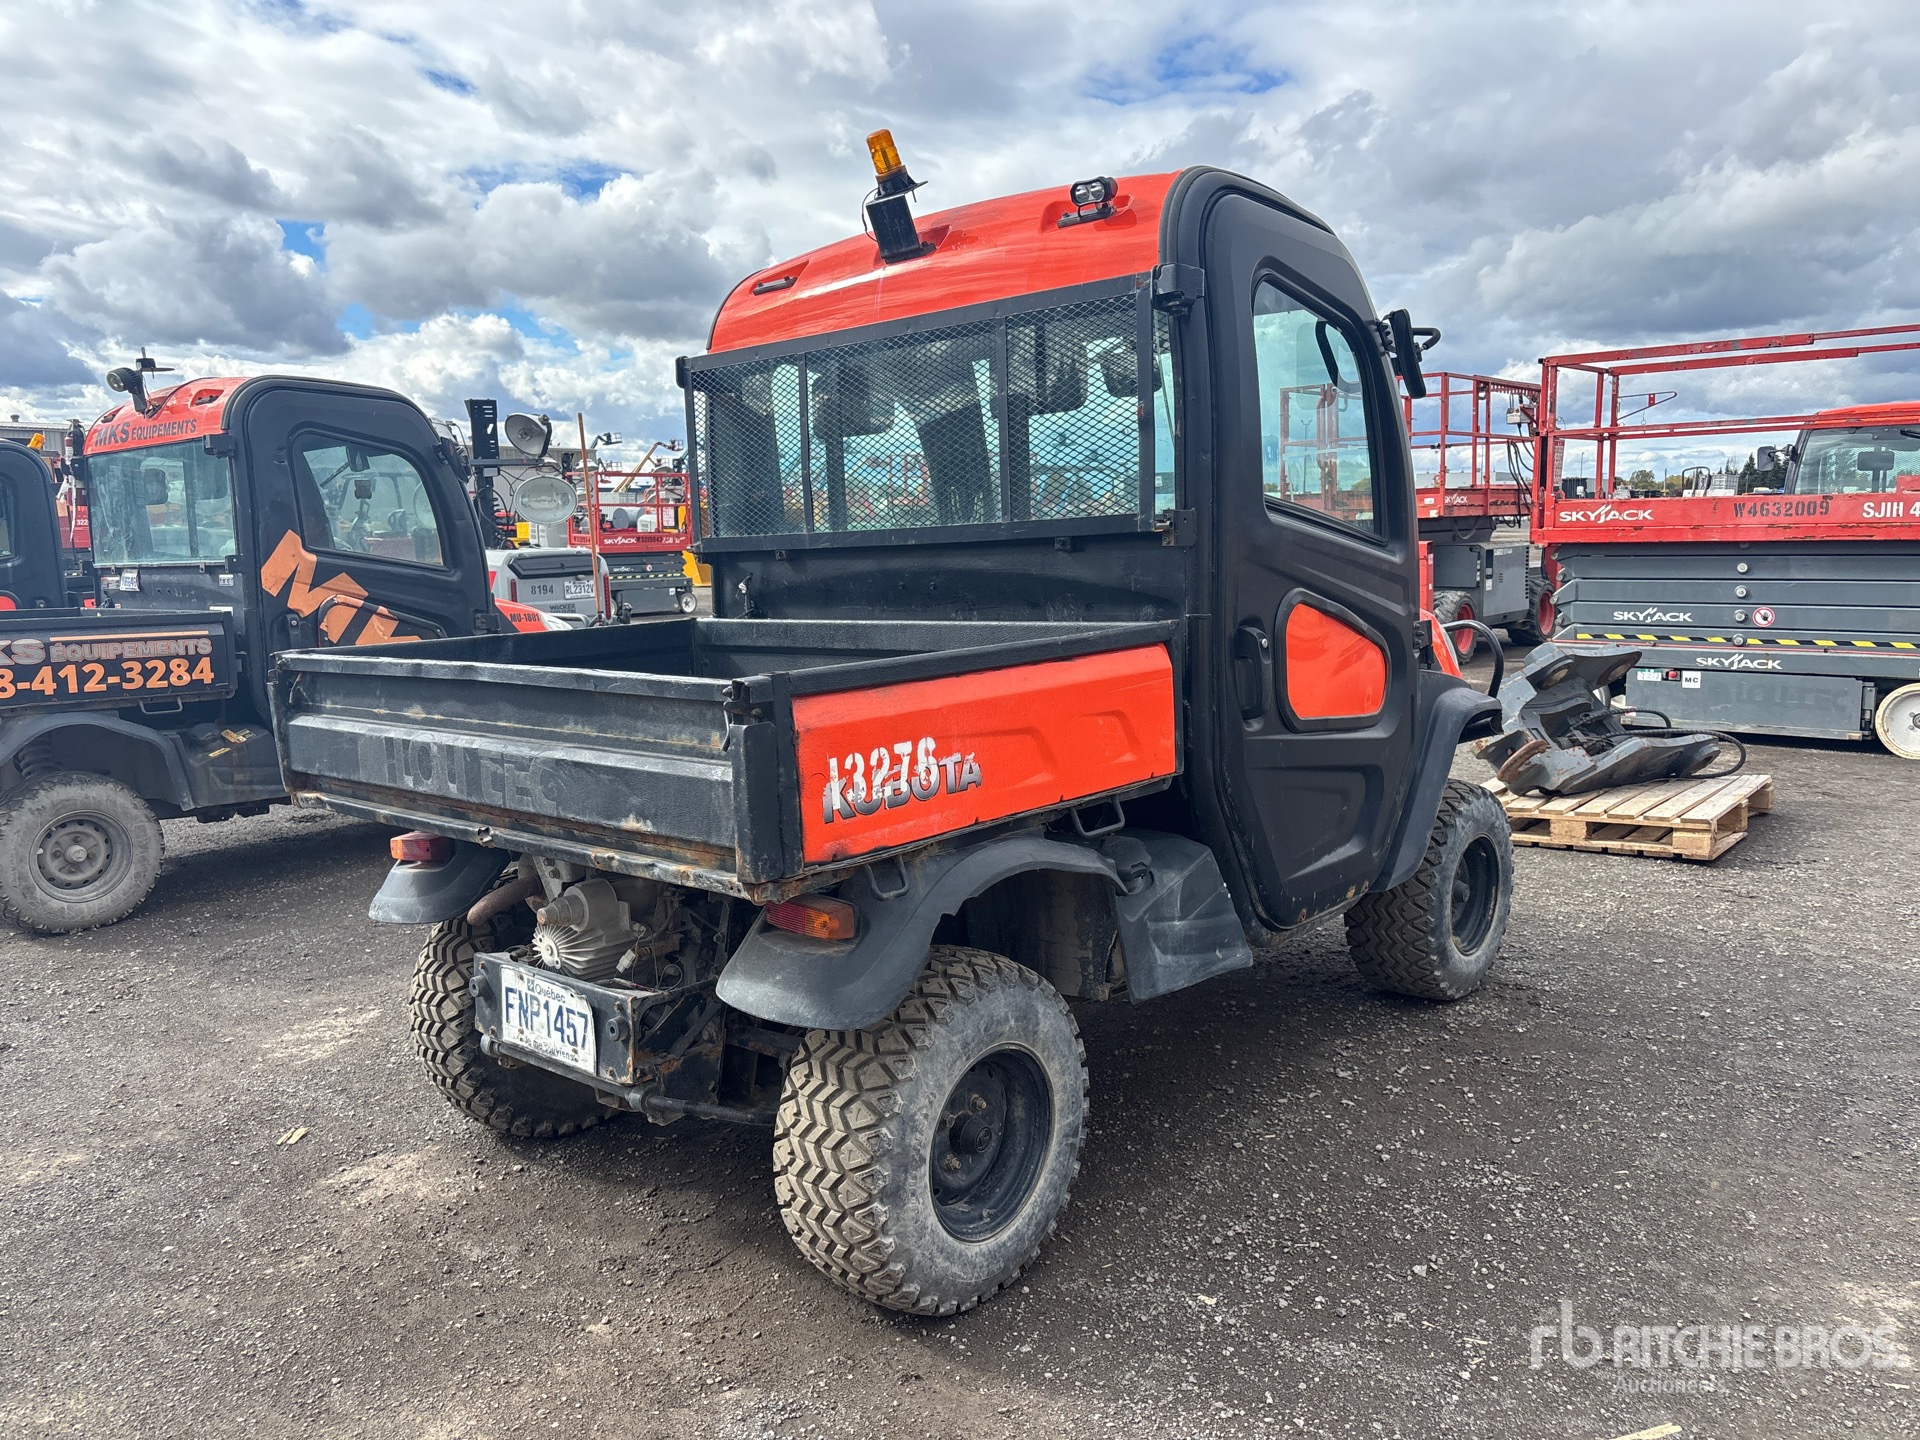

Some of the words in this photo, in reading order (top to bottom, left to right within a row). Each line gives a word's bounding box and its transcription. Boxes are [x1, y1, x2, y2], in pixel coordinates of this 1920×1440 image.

[95, 421, 131, 448] MKS
[1559, 503, 1654, 524] SKYJACK
[1733, 500, 1831, 518] W4632009
[531, 584, 554, 595] 8194
[1613, 607, 1693, 623] SKYJACK
[50, 638, 213, 663] ÉQUIPEMENTS
[1696, 653, 1783, 670] SKYJACK
[0, 656, 214, 699] 8-412-3284
[505, 986, 588, 1051] FNP1457
